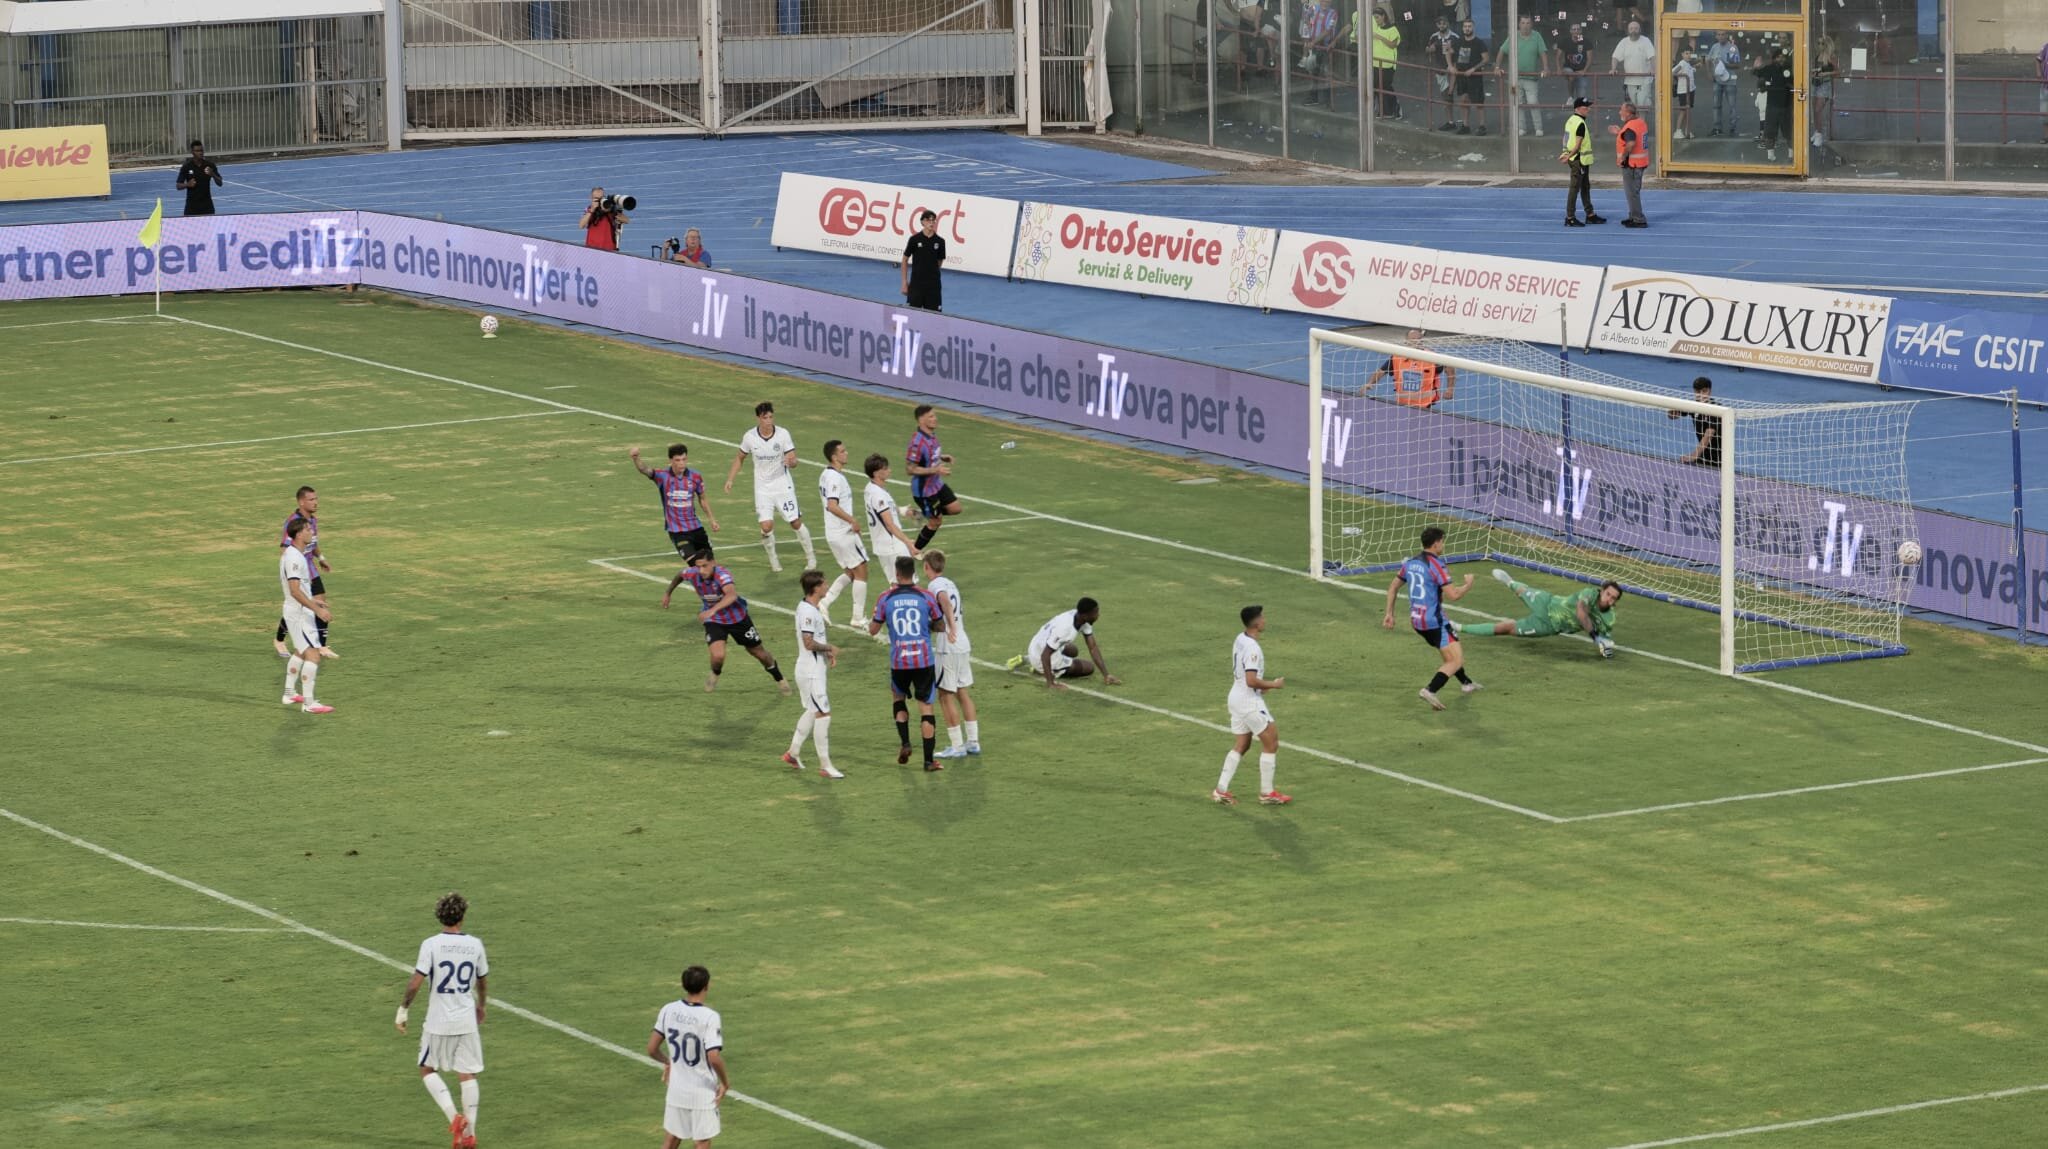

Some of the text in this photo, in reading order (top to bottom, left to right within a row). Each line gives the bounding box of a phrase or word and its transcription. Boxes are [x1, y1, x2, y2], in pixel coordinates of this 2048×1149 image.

[1060, 213, 1222, 266] OrtoService
[126, 243, 206, 287] per
[394, 235, 440, 278] che
[446, 239, 525, 294] innova
[575, 266, 599, 308] te
[1077, 258, 1193, 291] Servizi & Delivery
[1368, 256, 1581, 299] NEW SPLENDOR SERVICE
[1396, 288, 1539, 324] Società di servizi
[1603, 287, 1885, 358] AUTO LUXURY
[1600, 331, 1669, 349] di Alberto Valenti
[1678, 343, 1699, 353] AUTO
[1700, 345, 1711, 355] DA
[1712, 346, 1753, 361] CERIMONIA
[1758, 352, 1798, 366] NOLEGGIO
[1799, 357, 1816, 368] CON
[1817, 360, 1869, 374] CONDUCENTE
[1895, 322, 1964, 358] FAAC
[1974, 334, 2045, 374] CESIT
[744, 295, 756, 339] il
[762, 310, 853, 359] partner
[1020, 354, 1071, 403] che
[1181, 392, 1230, 439] per
[1236, 397, 1265, 443] te
[892, 607, 921, 637] 68
[436, 960, 474, 994] 29
[668, 1027, 701, 1067] 30
